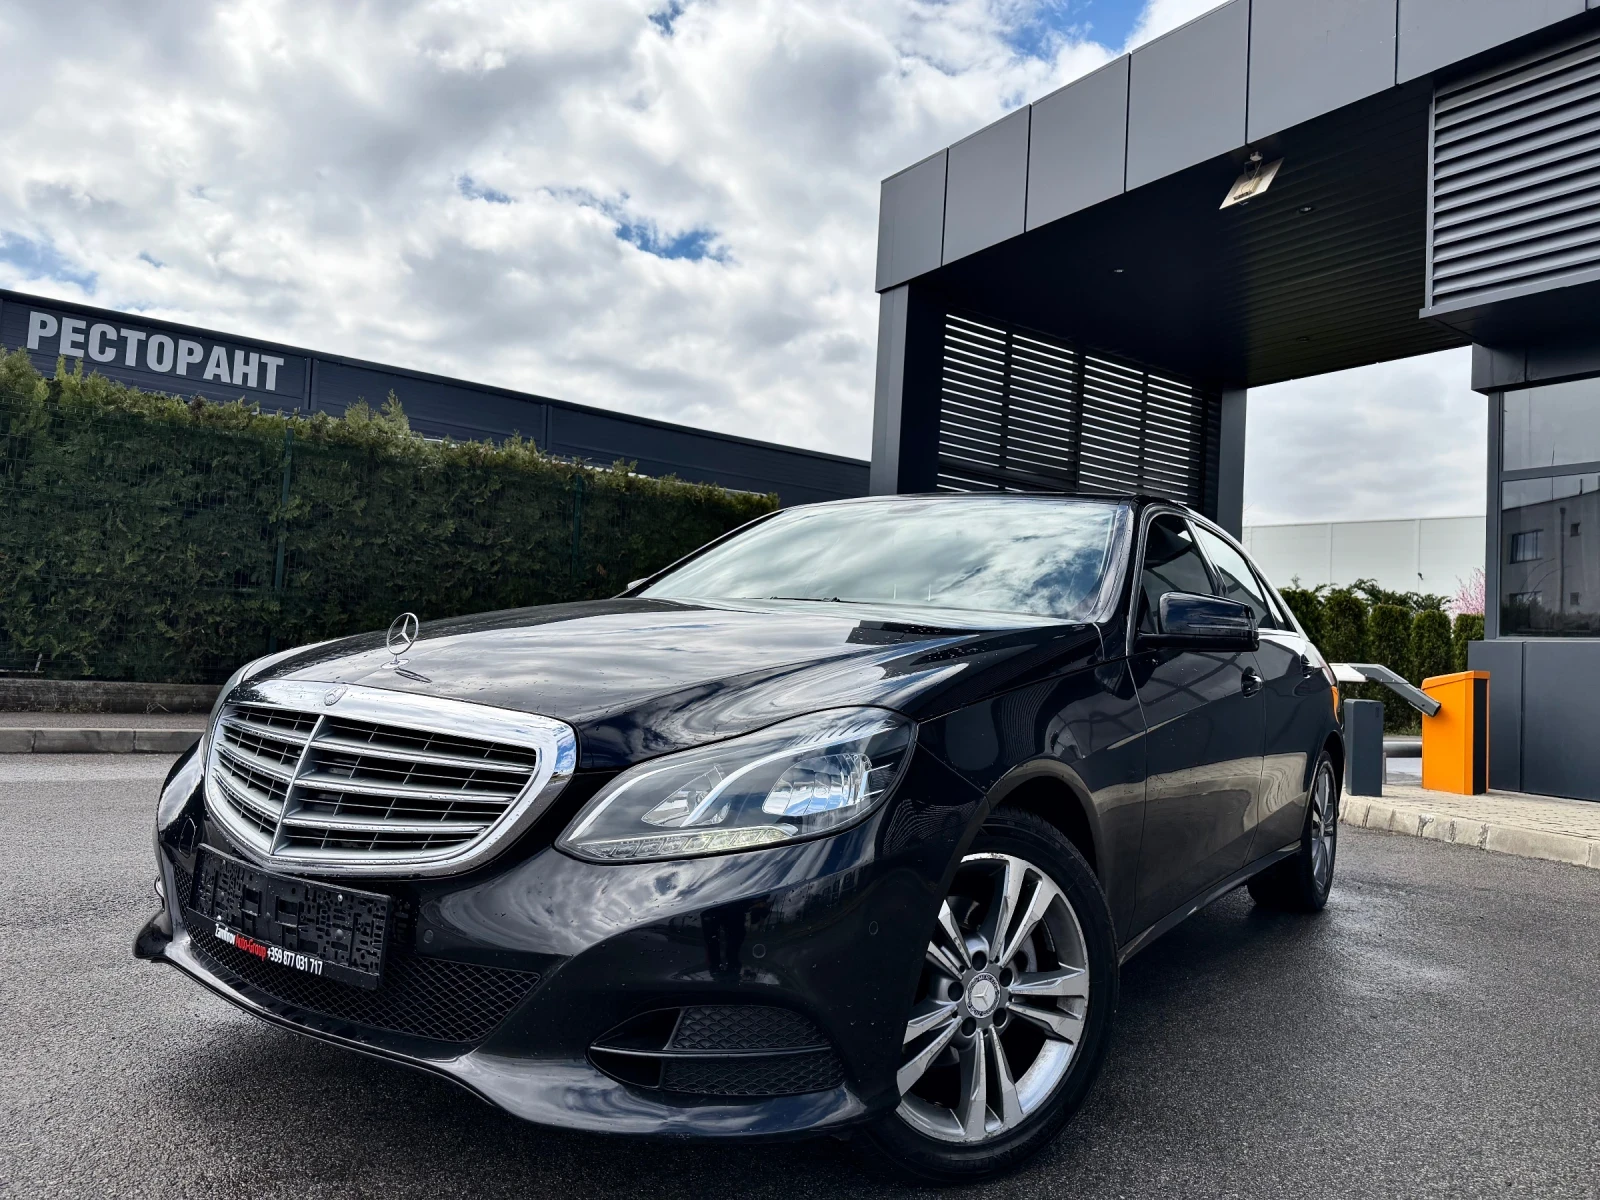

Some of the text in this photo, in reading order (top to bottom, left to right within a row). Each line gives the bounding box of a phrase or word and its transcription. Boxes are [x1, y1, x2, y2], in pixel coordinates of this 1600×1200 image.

[27, 311, 285, 391] РЕСТОРАНТ
[267, 946, 282, 963] +359
[283, 951, 295, 968] 877
[295, 954, 308, 972] 031
[309, 958, 323, 976] 717
